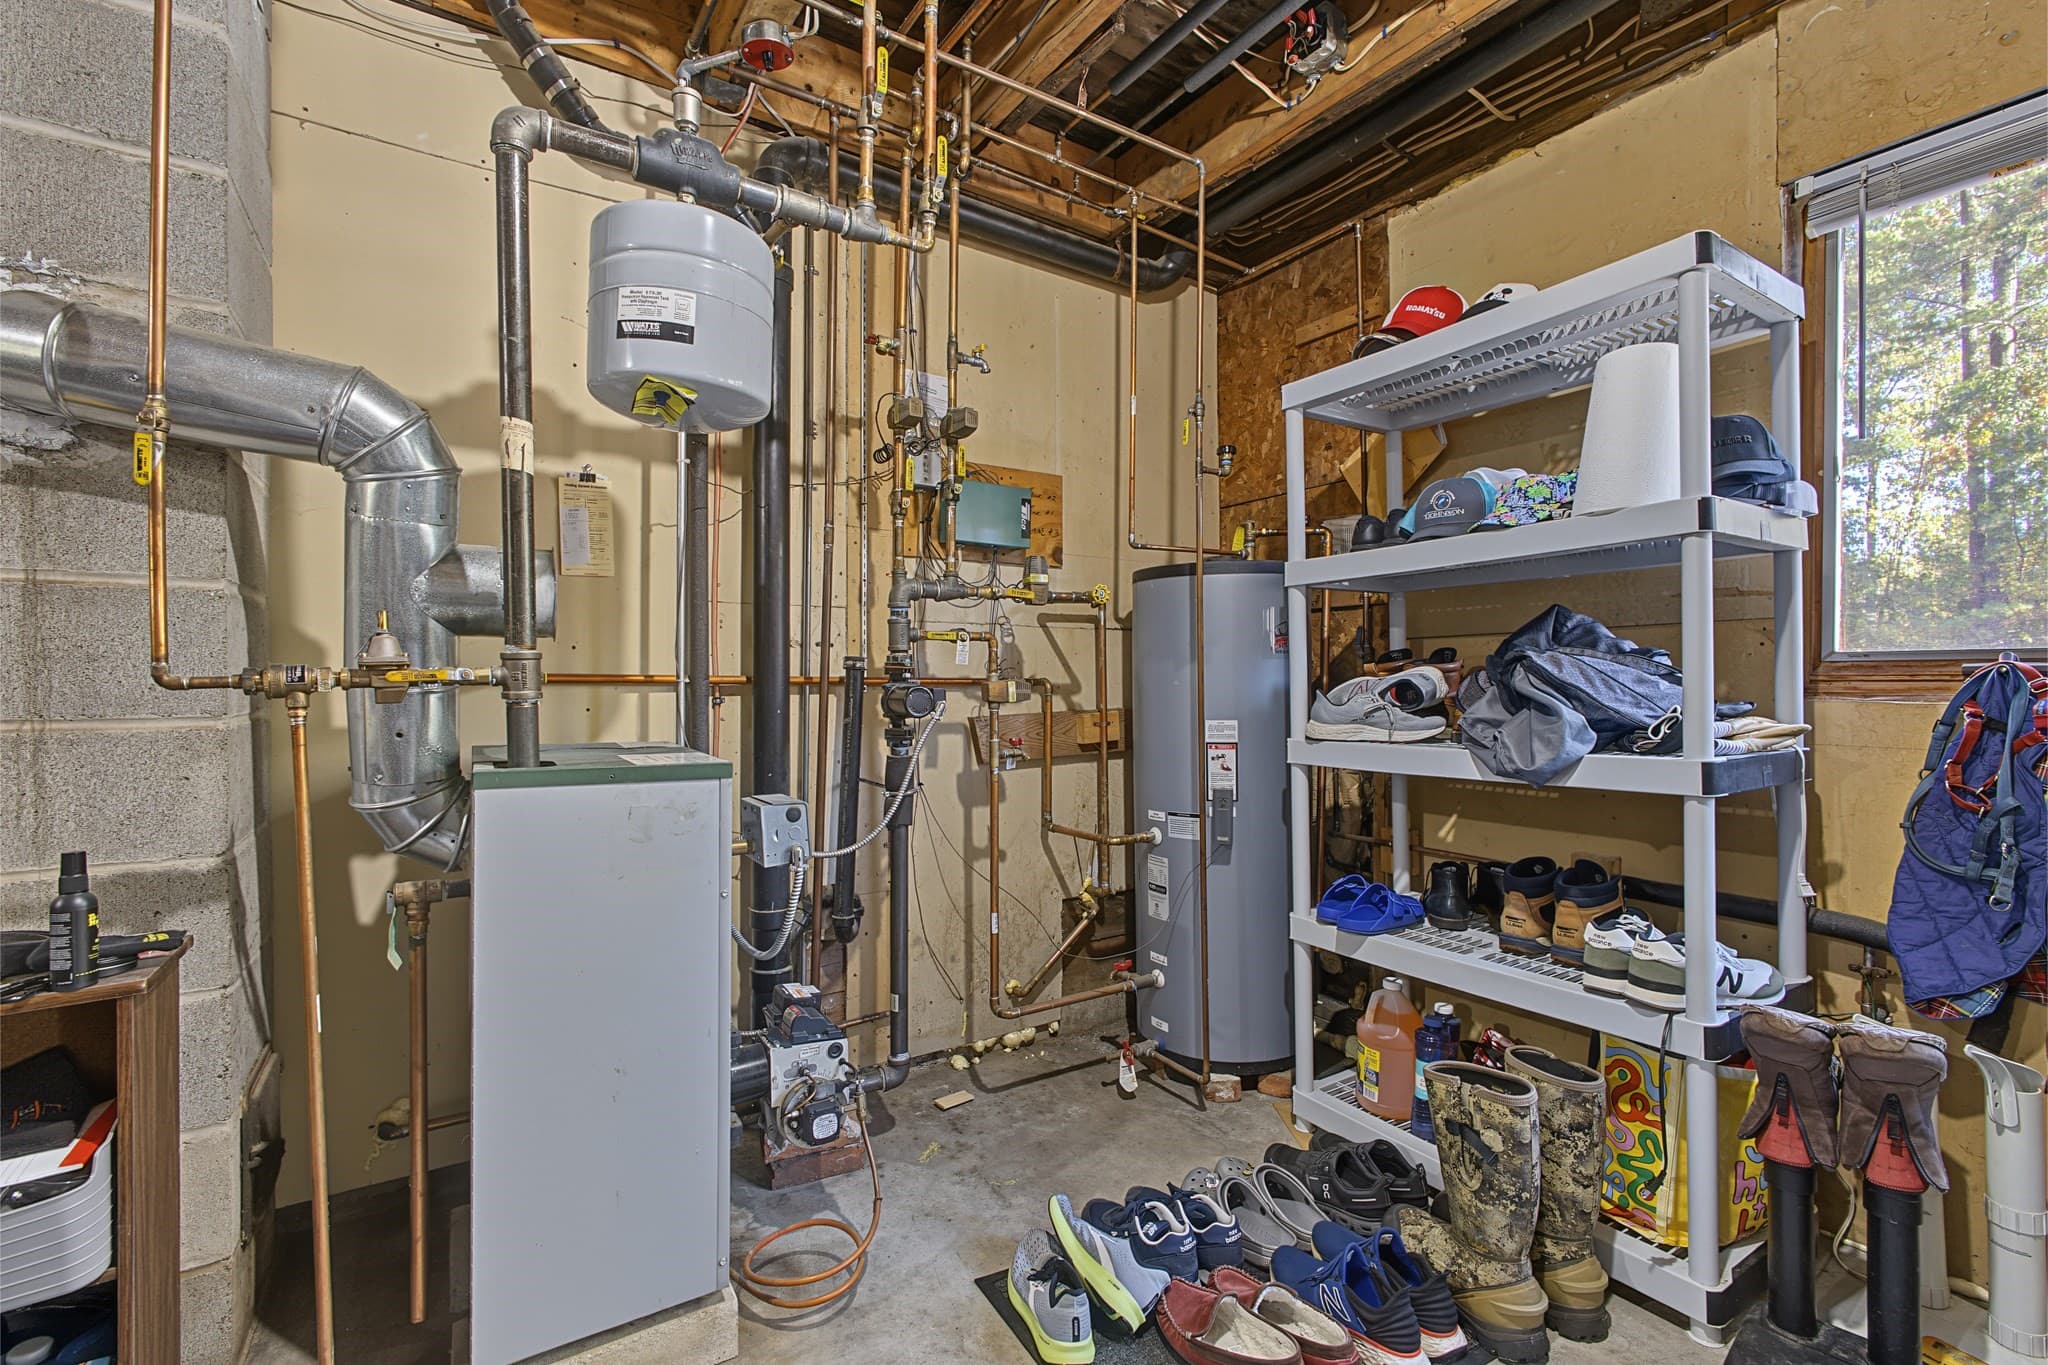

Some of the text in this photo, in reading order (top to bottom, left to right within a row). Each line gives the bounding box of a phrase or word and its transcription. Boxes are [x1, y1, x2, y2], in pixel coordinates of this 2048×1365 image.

[1405, 304, 1446, 320] KOMATSU
[1593, 932, 1606, 940] new
[1588, 936, 1613, 947] balance
[1636, 942, 1649, 950] new
